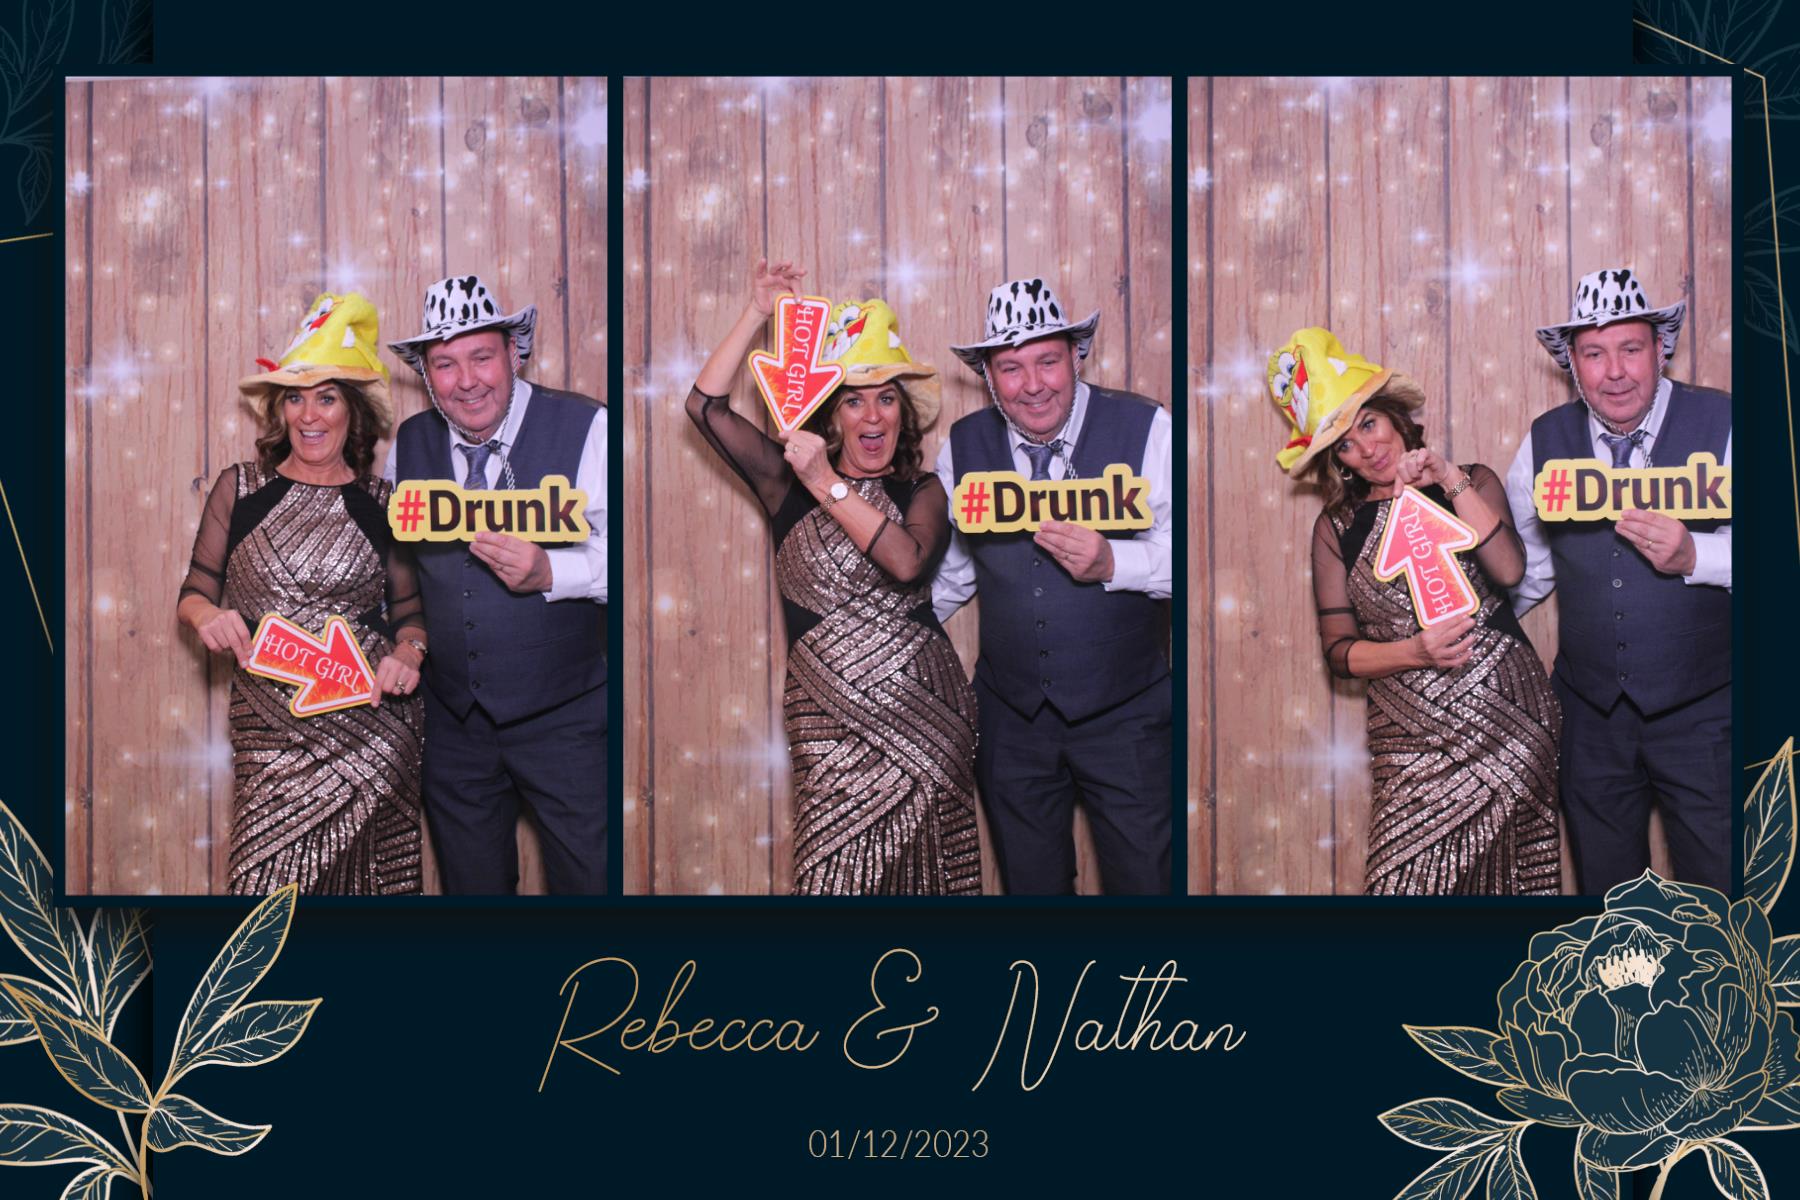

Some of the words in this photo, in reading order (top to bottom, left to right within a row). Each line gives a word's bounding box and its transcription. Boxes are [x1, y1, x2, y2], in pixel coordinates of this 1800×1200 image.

[792, 305, 815, 361] HOT
[781, 363, 807, 415] GIRL
[396, 485, 580, 532] #Drunk
[961, 474, 1144, 524] #Drunk
[1541, 462, 1728, 513] #Drunk
[1400, 503, 1434, 560] GIRL
[1417, 565, 1454, 615] HOT
[264, 632, 317, 667] HOT
[315, 656, 362, 694] GIRL
